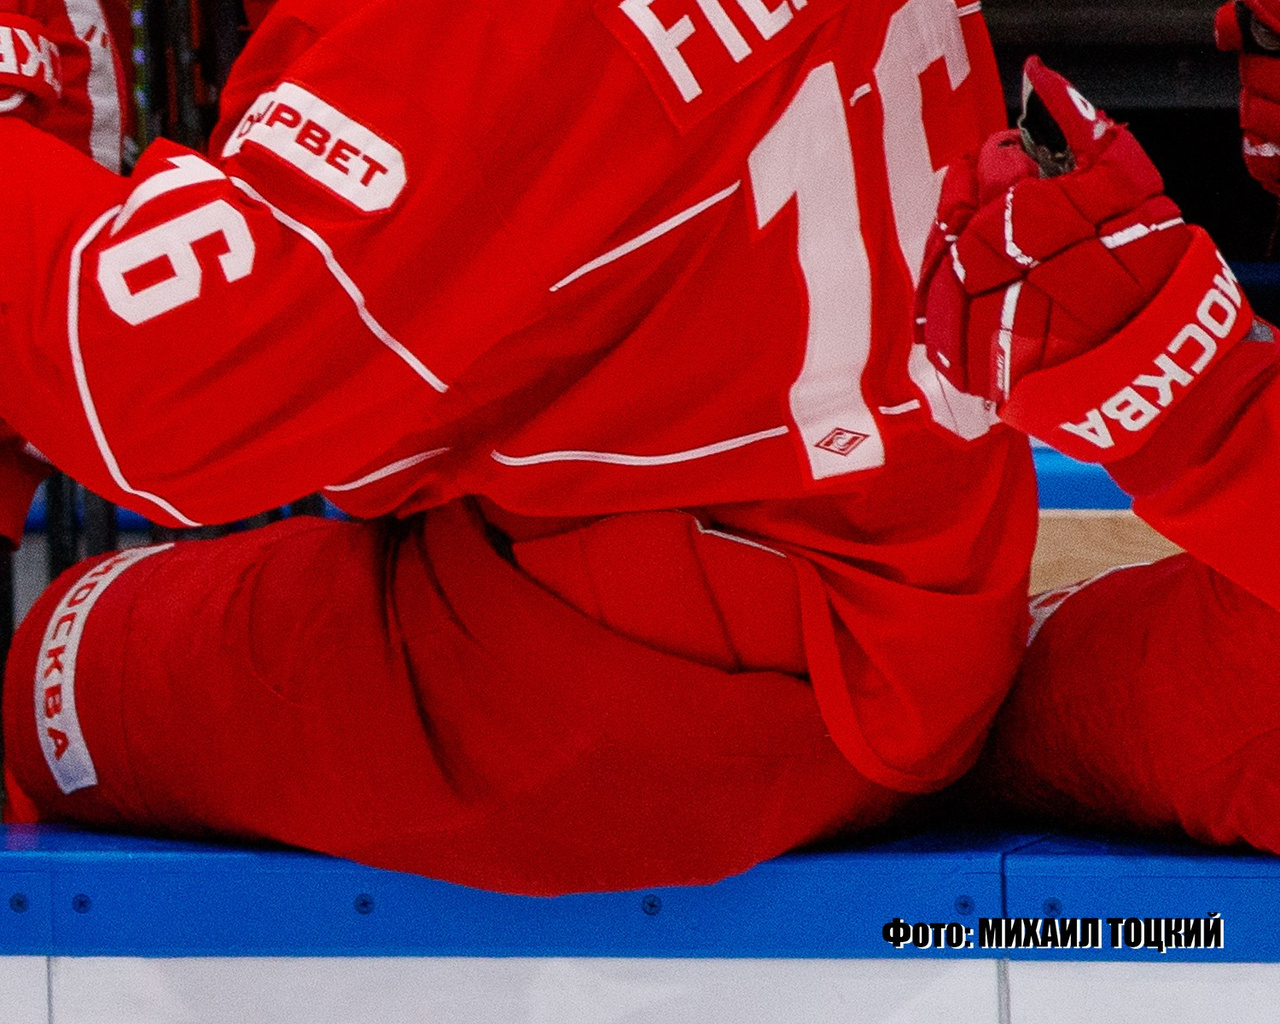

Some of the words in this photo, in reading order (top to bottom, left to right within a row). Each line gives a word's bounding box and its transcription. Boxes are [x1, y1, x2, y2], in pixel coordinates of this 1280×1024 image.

[238, 100, 389, 187] PBET
[97, 153, 256, 327] 16
[1060, 248, 1243, 450] МОСКВА
